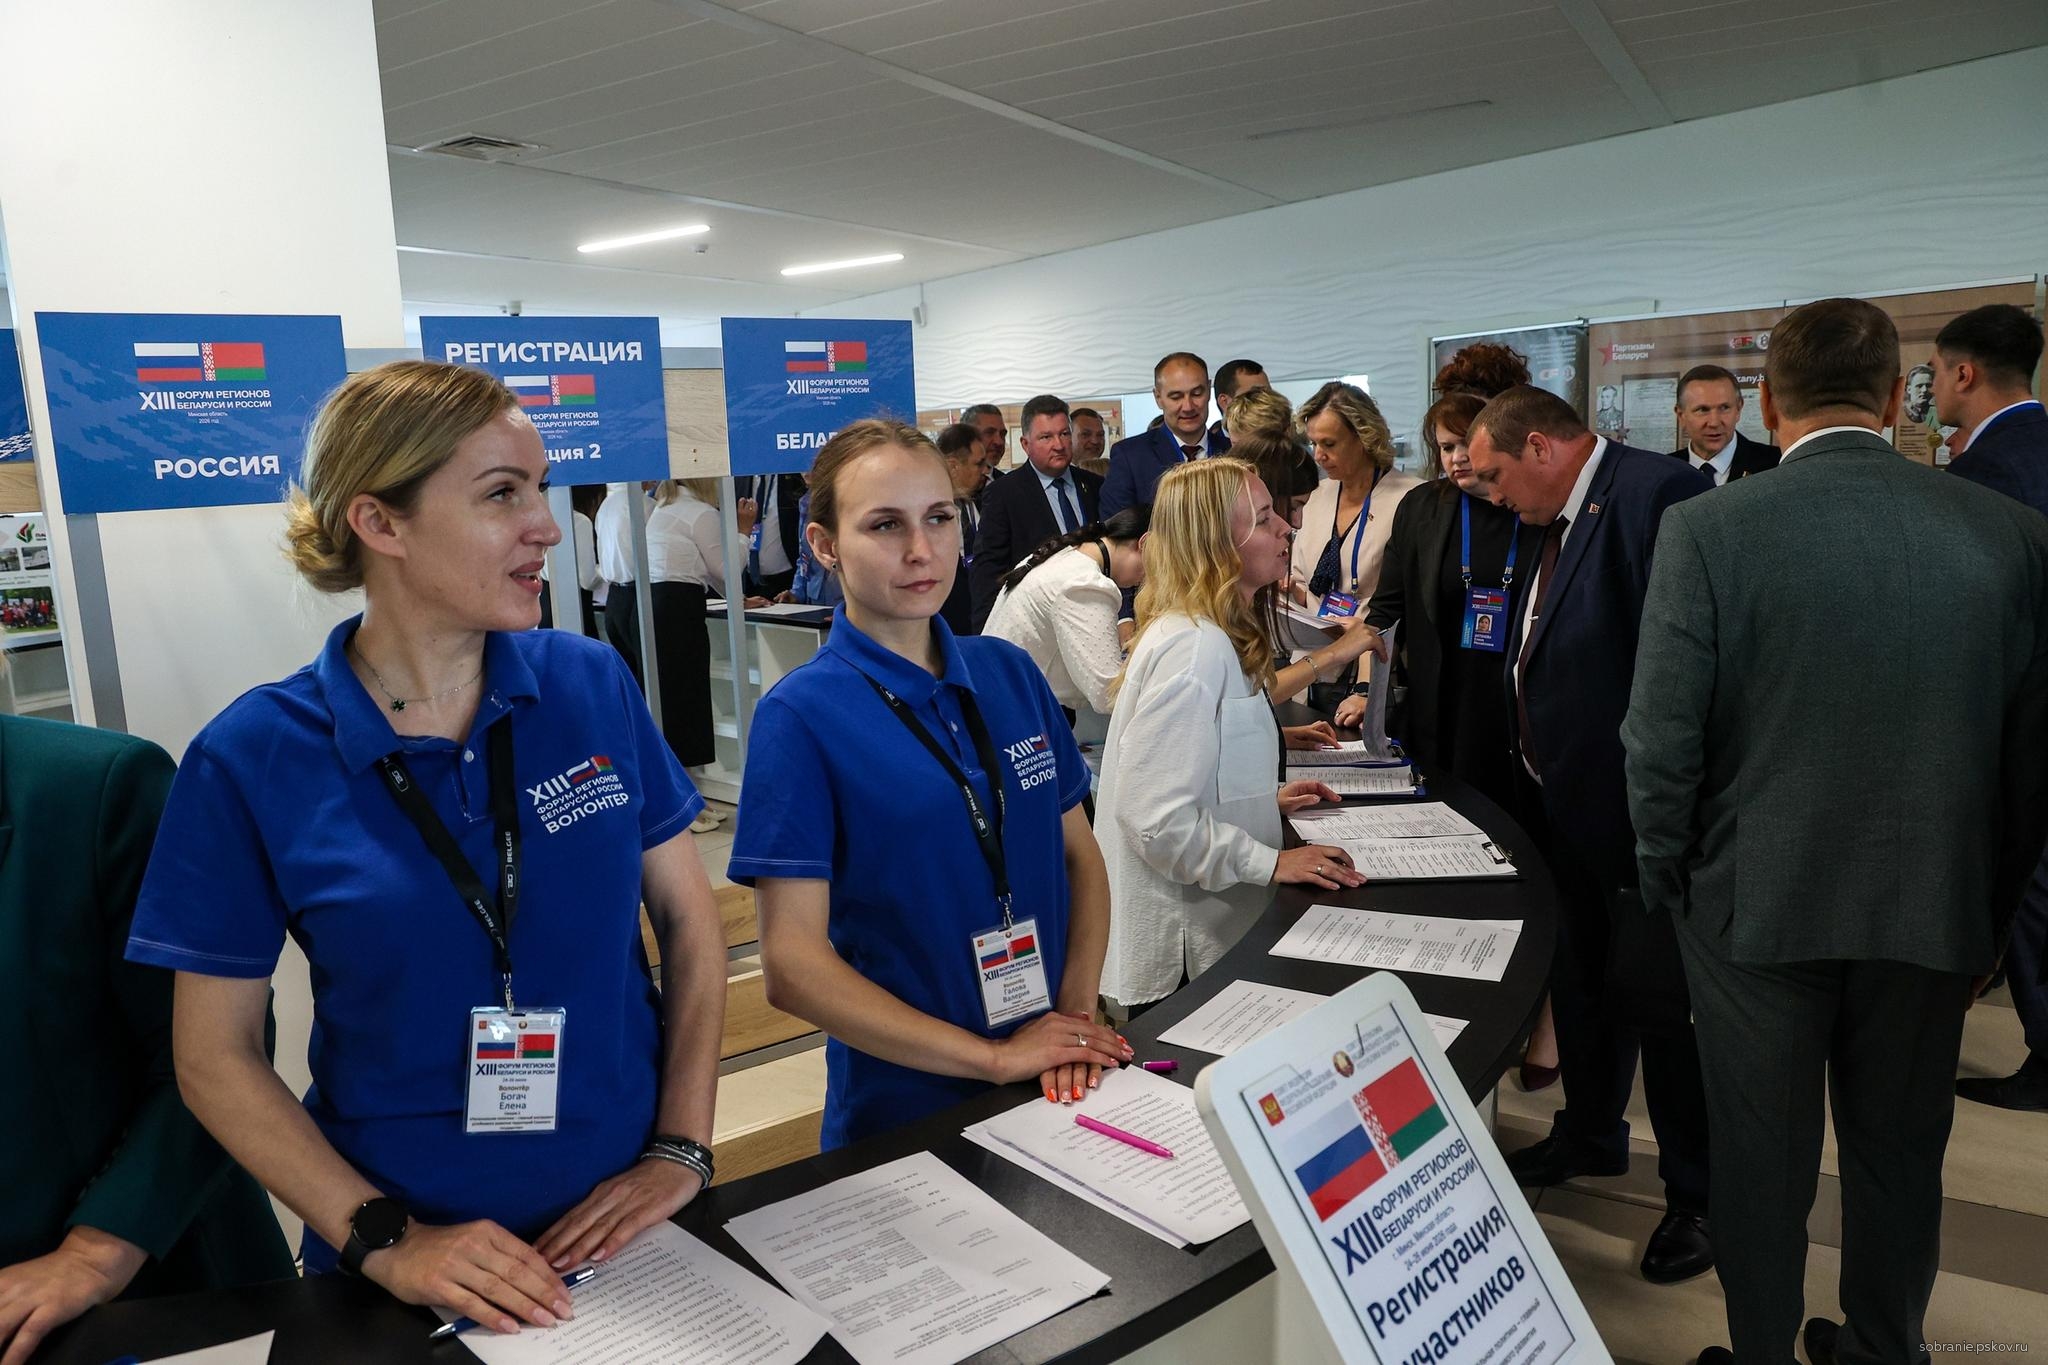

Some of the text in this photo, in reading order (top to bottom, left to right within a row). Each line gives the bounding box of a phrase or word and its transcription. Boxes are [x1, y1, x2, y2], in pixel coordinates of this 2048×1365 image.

[445, 342, 643, 364] РЕГИСТРАЦИЯ
[786, 380, 808, 394] XIII
[834, 378, 869, 386] РЕГИОНОВ
[138, 390, 271, 411] XIII ФОРУМ РЕГИОНОВ
[177, 400, 272, 410] БЕЛАРУСИ И РОССИИ
[532, 412, 558, 420] ФОРУМ
[560, 412, 598, 420] РЕГИОНОВ
[588, 444, 601, 459] 2
[154, 455, 280, 480] РОССИЯ
[1004, 740, 1035, 762] XIII
[1014, 754, 1039, 770] ФОРУМ
[526, 774, 571, 806] XIII
[536, 774, 619, 814] ФОРУМ РЕГИОНОВ
[540, 783, 624, 822] БЕЛАРУСИ И РОССИИ
[545, 792, 629, 834] ВОЛОНТЕР
[504, 831, 512, 863] BELGEE
[984, 970, 1000, 982] XIII
[476, 1064, 496, 1076] XIII
[499, 1102, 526, 1110] Елена
[501, 1092, 526, 1100] Богач
[1331, 1138, 1467, 1276] XIII ФОРУМ РЕГИОНОВ
[1382, 1158, 1478, 1244] БЕЛАРУСИ И РОССИИ
[1366, 1205, 1506, 1340] Регистрация
